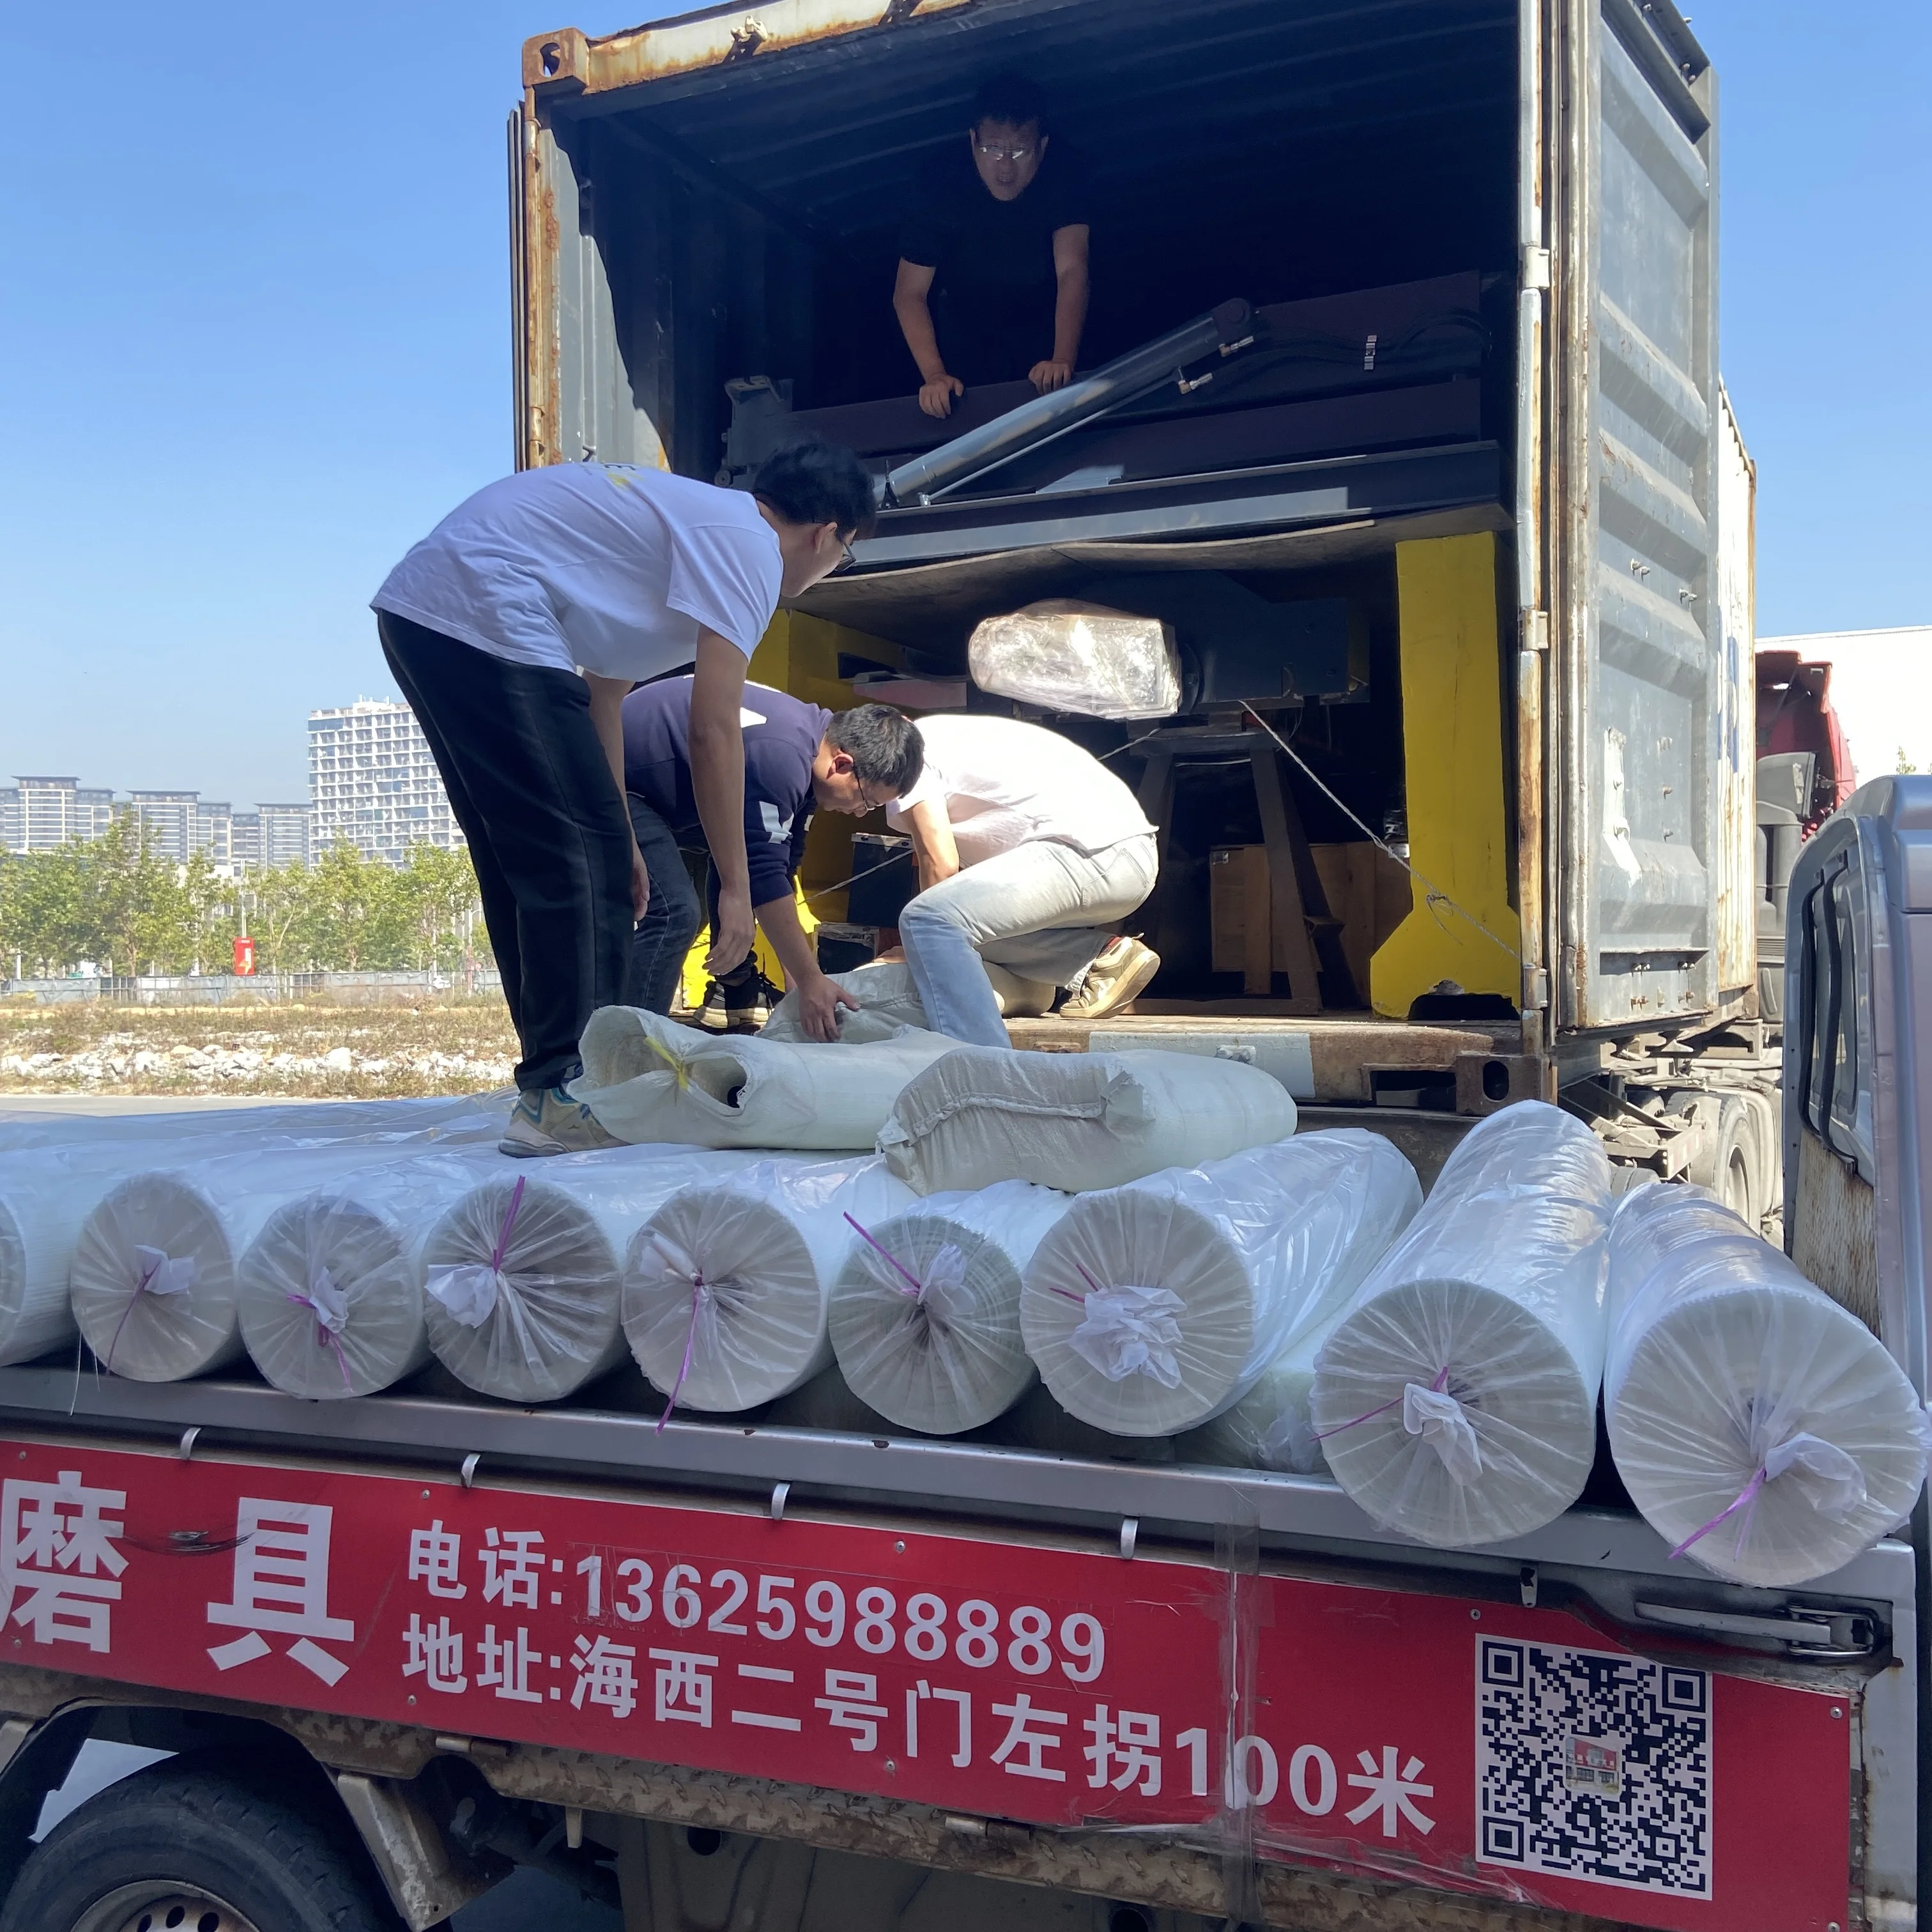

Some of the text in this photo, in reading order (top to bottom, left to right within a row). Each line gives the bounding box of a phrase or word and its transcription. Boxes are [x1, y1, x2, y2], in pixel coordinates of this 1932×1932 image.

[0, 1470, 355, 1687] 磨具
[409, 1519, 1106, 1683] 电话:13625988889
[402, 1614, 1437, 1838] 地址:海西二号门左拐100米
